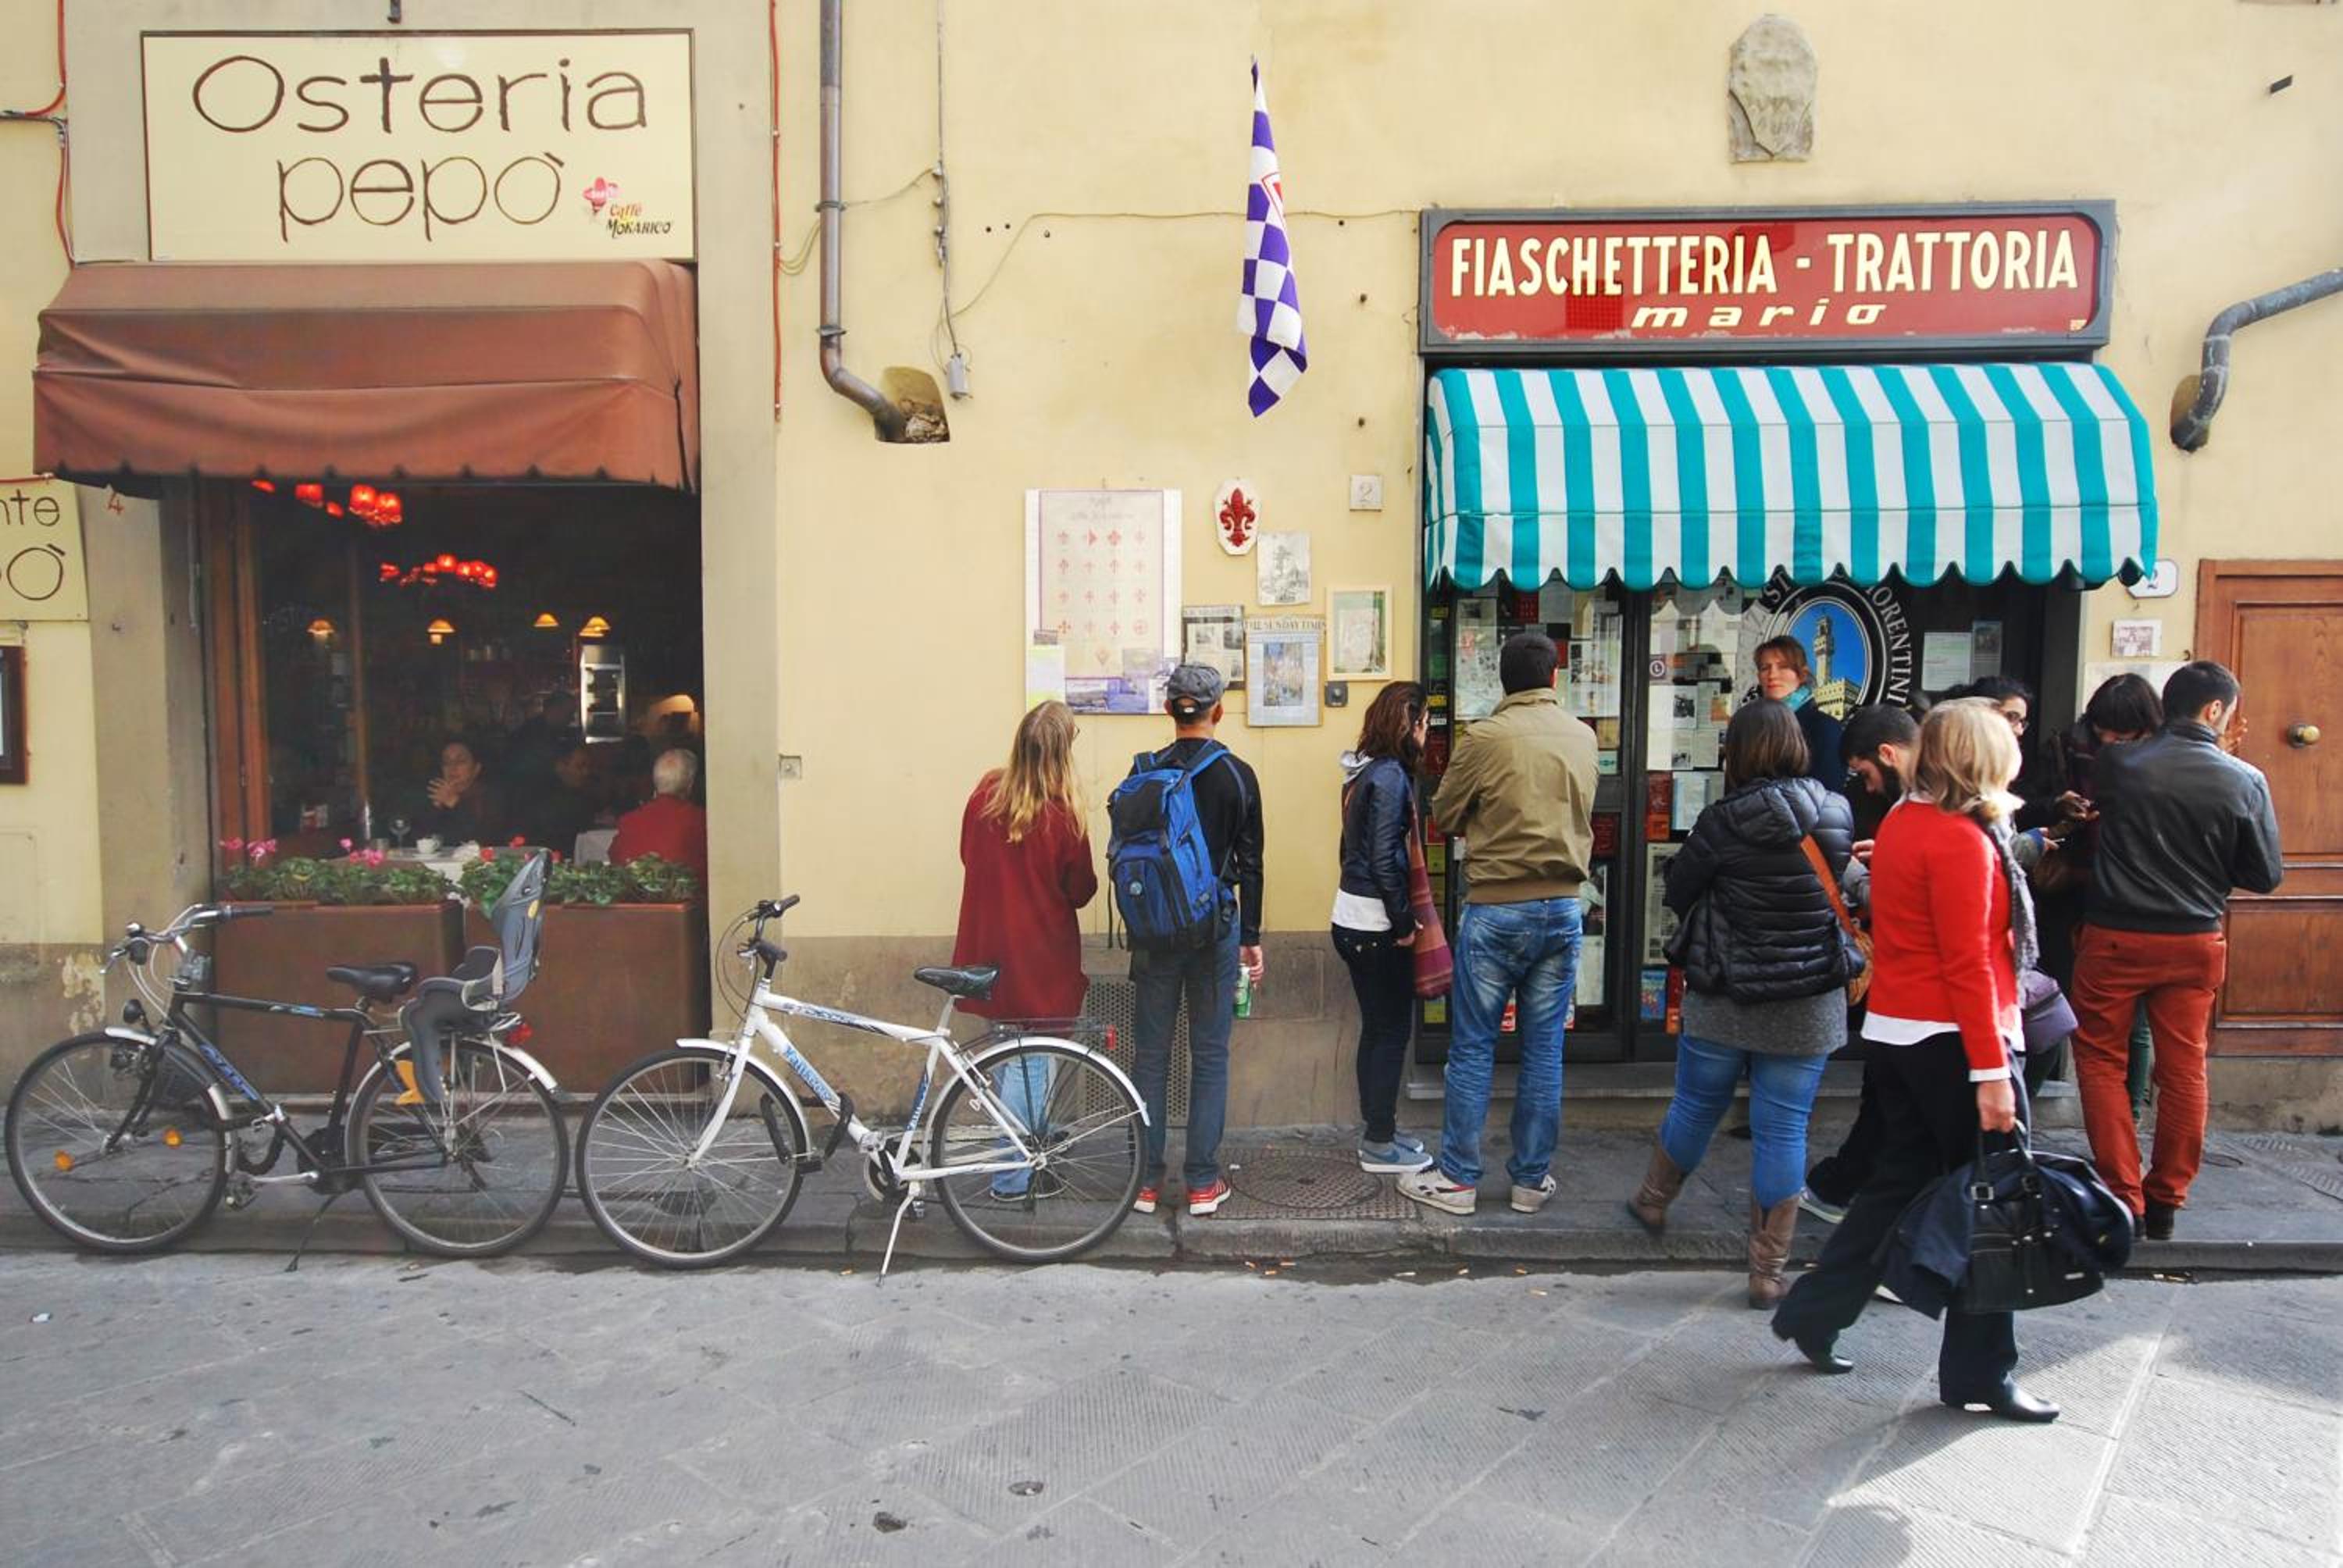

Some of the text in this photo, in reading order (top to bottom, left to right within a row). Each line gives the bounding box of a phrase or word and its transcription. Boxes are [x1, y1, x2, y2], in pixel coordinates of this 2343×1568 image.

[192, 55, 647, 134] Osteria
[276, 151, 565, 244] pepò
[1451, 234, 1778, 297] FIASCHETTERIA
[1827, 229, 2079, 292] TRATTORIA
[1631, 298, 1888, 329] mario
[1866, 585, 1913, 704] ORENTINI
